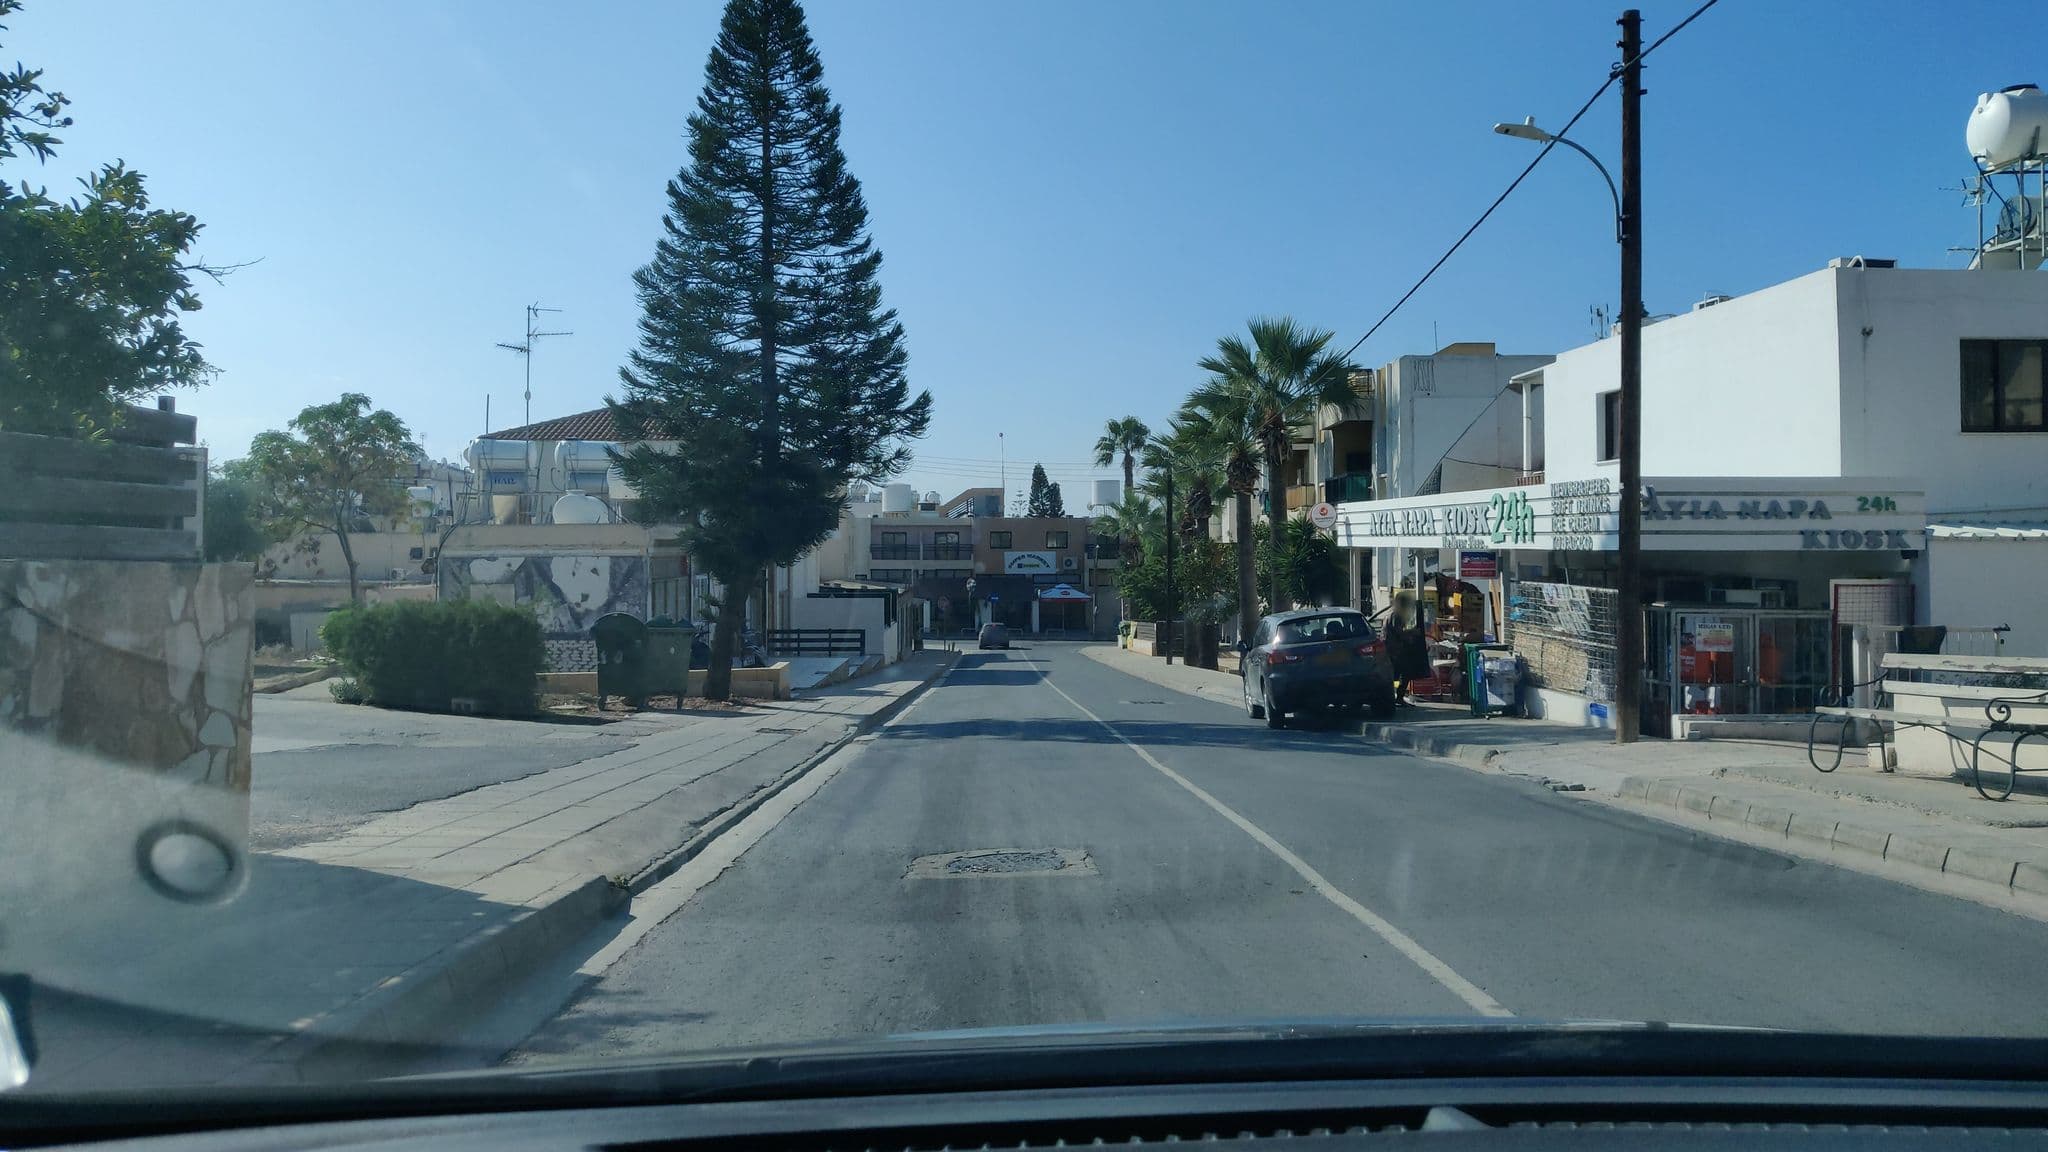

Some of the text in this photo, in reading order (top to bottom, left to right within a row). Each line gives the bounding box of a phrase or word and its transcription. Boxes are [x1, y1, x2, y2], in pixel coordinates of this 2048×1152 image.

[1551, 496, 1610, 515] SOFT DRINKS
[1645, 486, 1896, 520] AYIA NAPA 24h
[1369, 490, 1535, 545] AYIA NAPA KIOSK 24h
[1800, 529, 1911, 549] KIOSK
